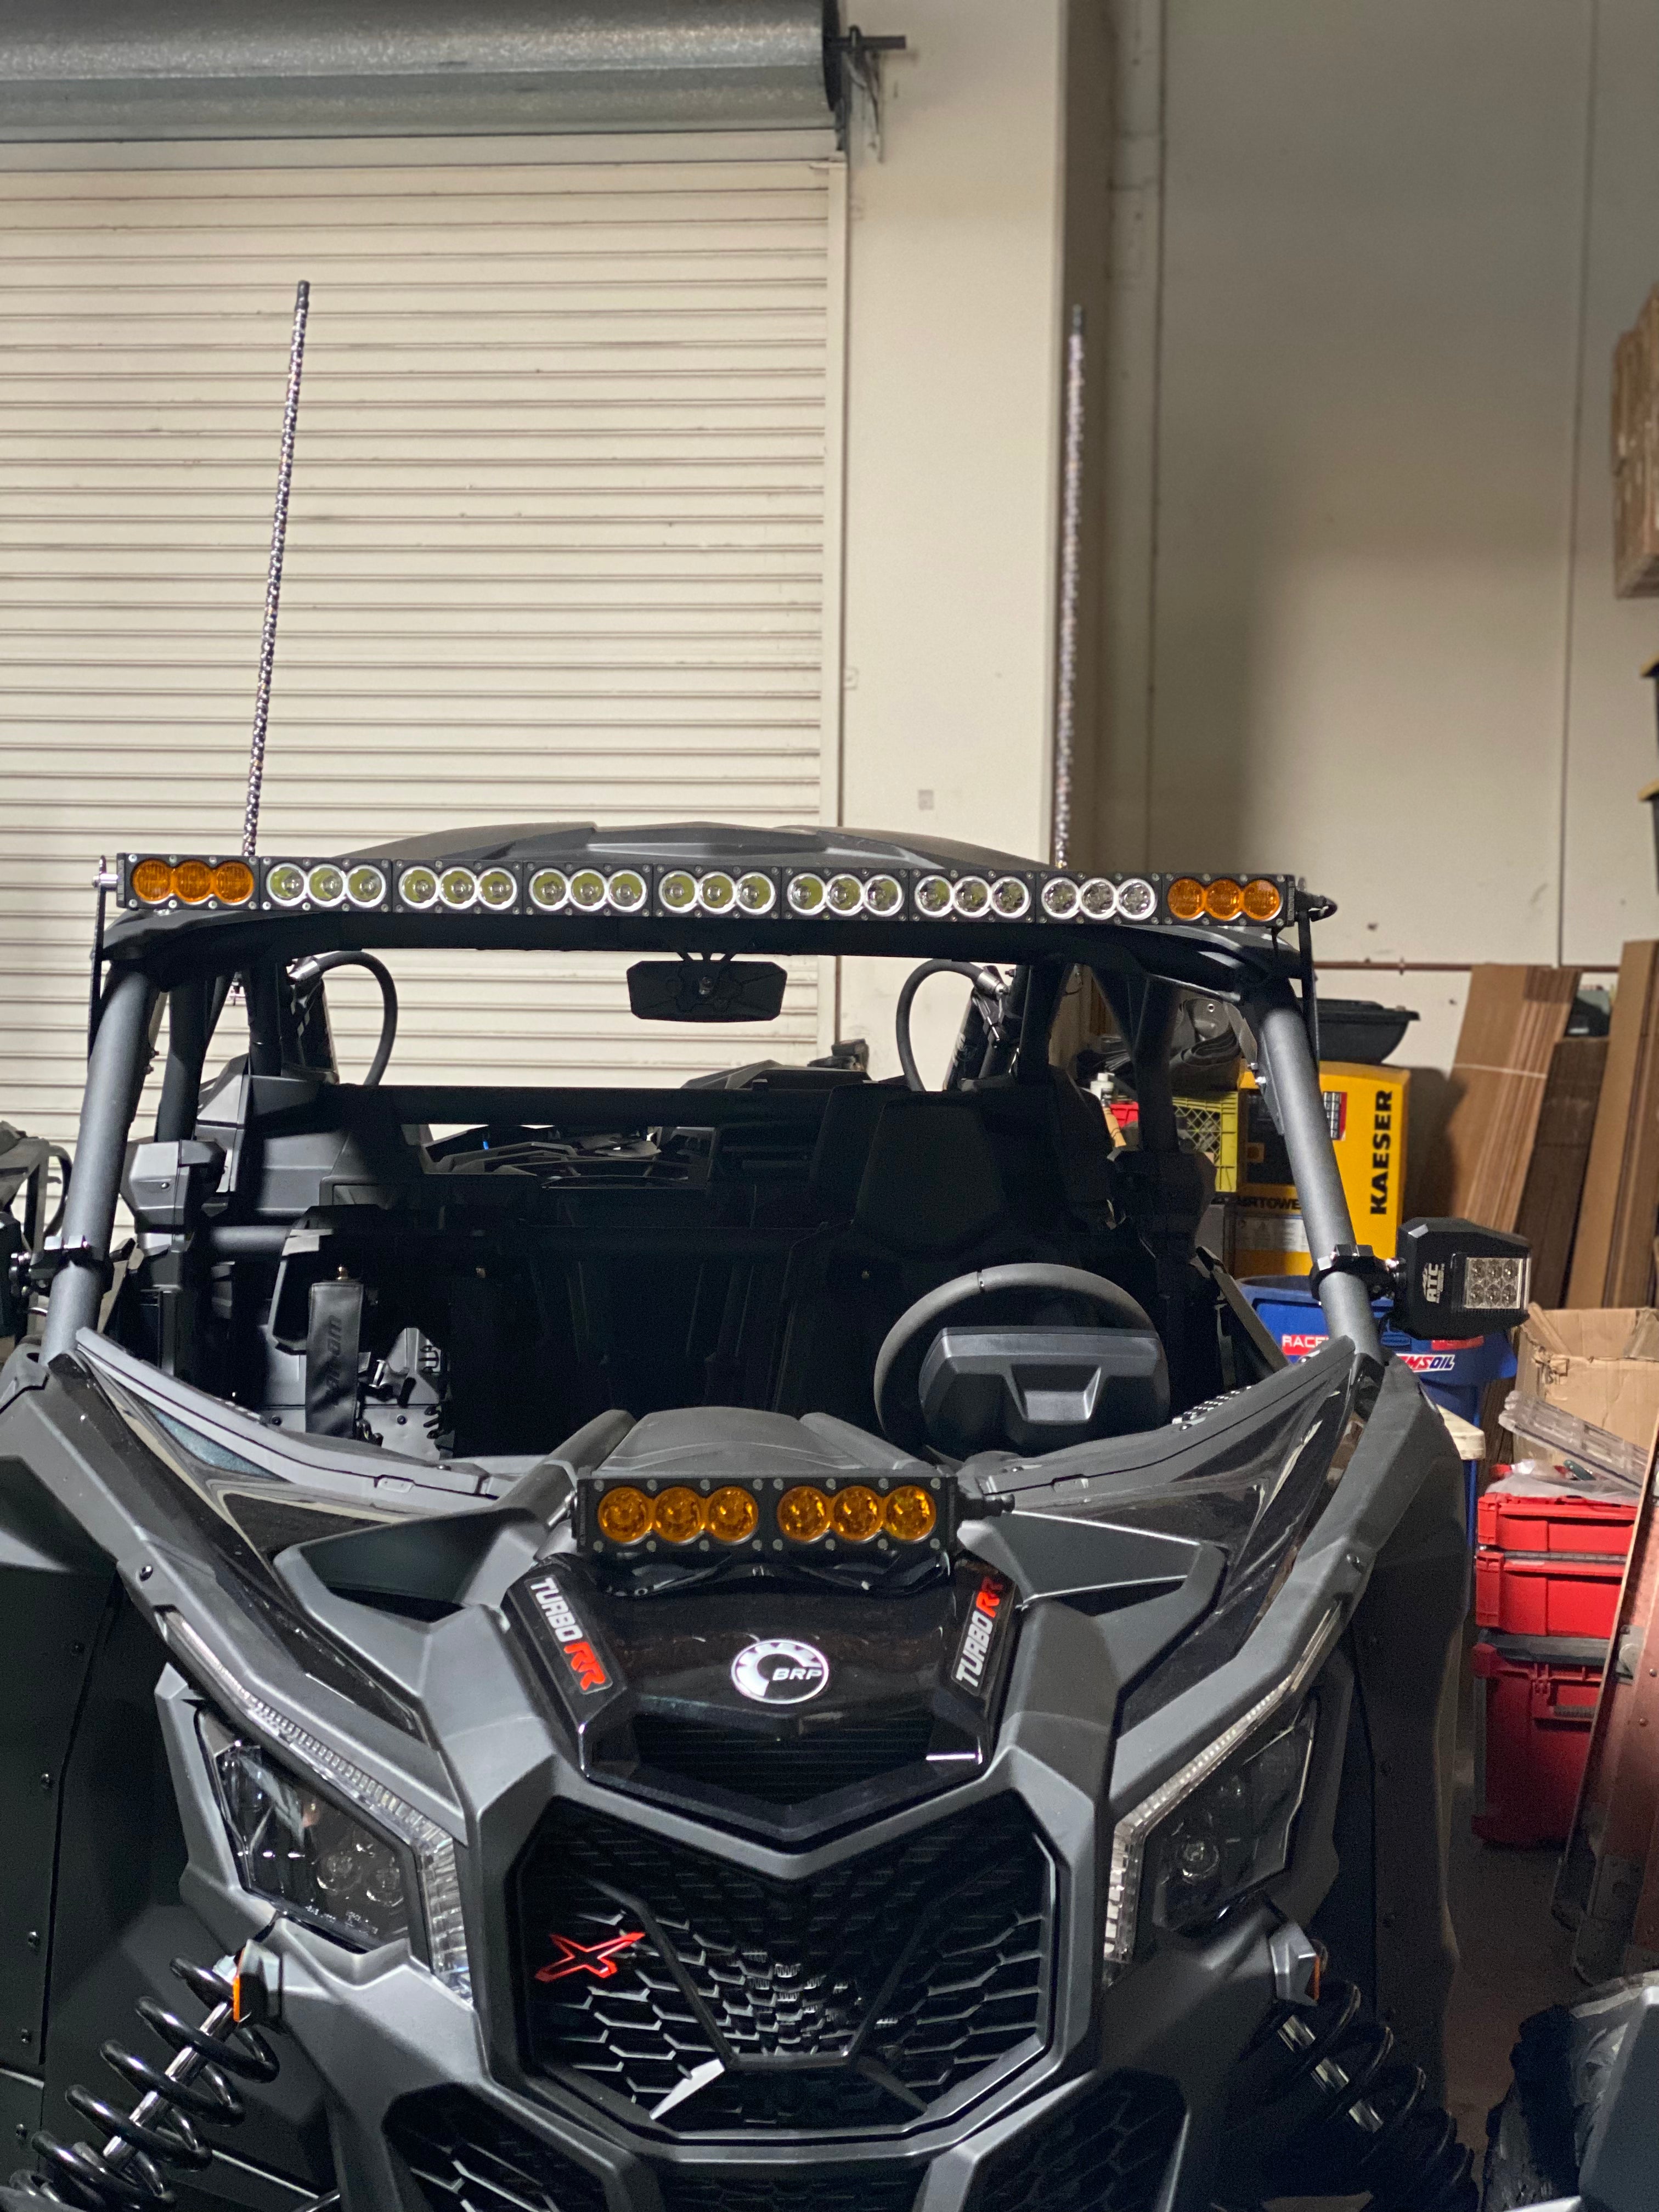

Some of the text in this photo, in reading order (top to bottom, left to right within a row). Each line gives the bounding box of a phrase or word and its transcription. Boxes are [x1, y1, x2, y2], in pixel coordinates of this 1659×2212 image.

[1370, 1090, 1392, 1215] KAESER
[1426, 1262, 1440, 1304] ATC
[1282, 1335, 1329, 1347] RACE
[530, 1577, 606, 1691] TURBO RR
[956, 1610, 993, 1687] TURBO
[772, 1667, 822, 1680] BRP
